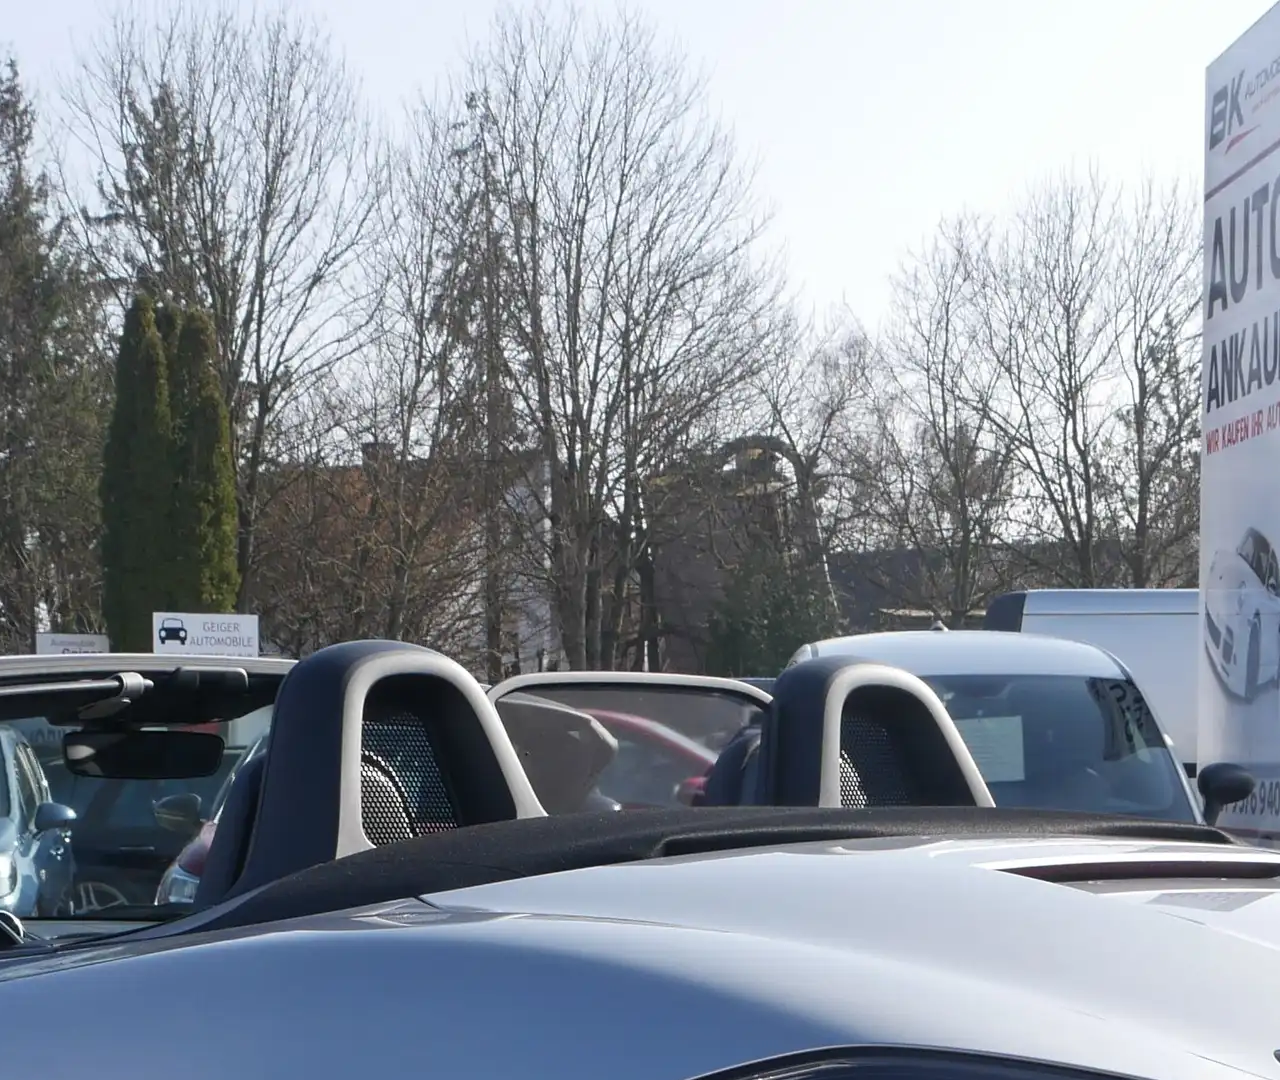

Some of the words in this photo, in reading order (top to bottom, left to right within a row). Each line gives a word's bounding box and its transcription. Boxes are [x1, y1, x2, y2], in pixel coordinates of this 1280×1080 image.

[1209, 68, 1245, 151] BK
[1206, 428, 1219, 456] WIR
[1222, 416, 1249, 450] KAUFEN
[1251, 409, 1263, 438] IHR
[203, 622, 239, 632] GEIGER
[190, 636, 254, 648] AUTOMOBILE
